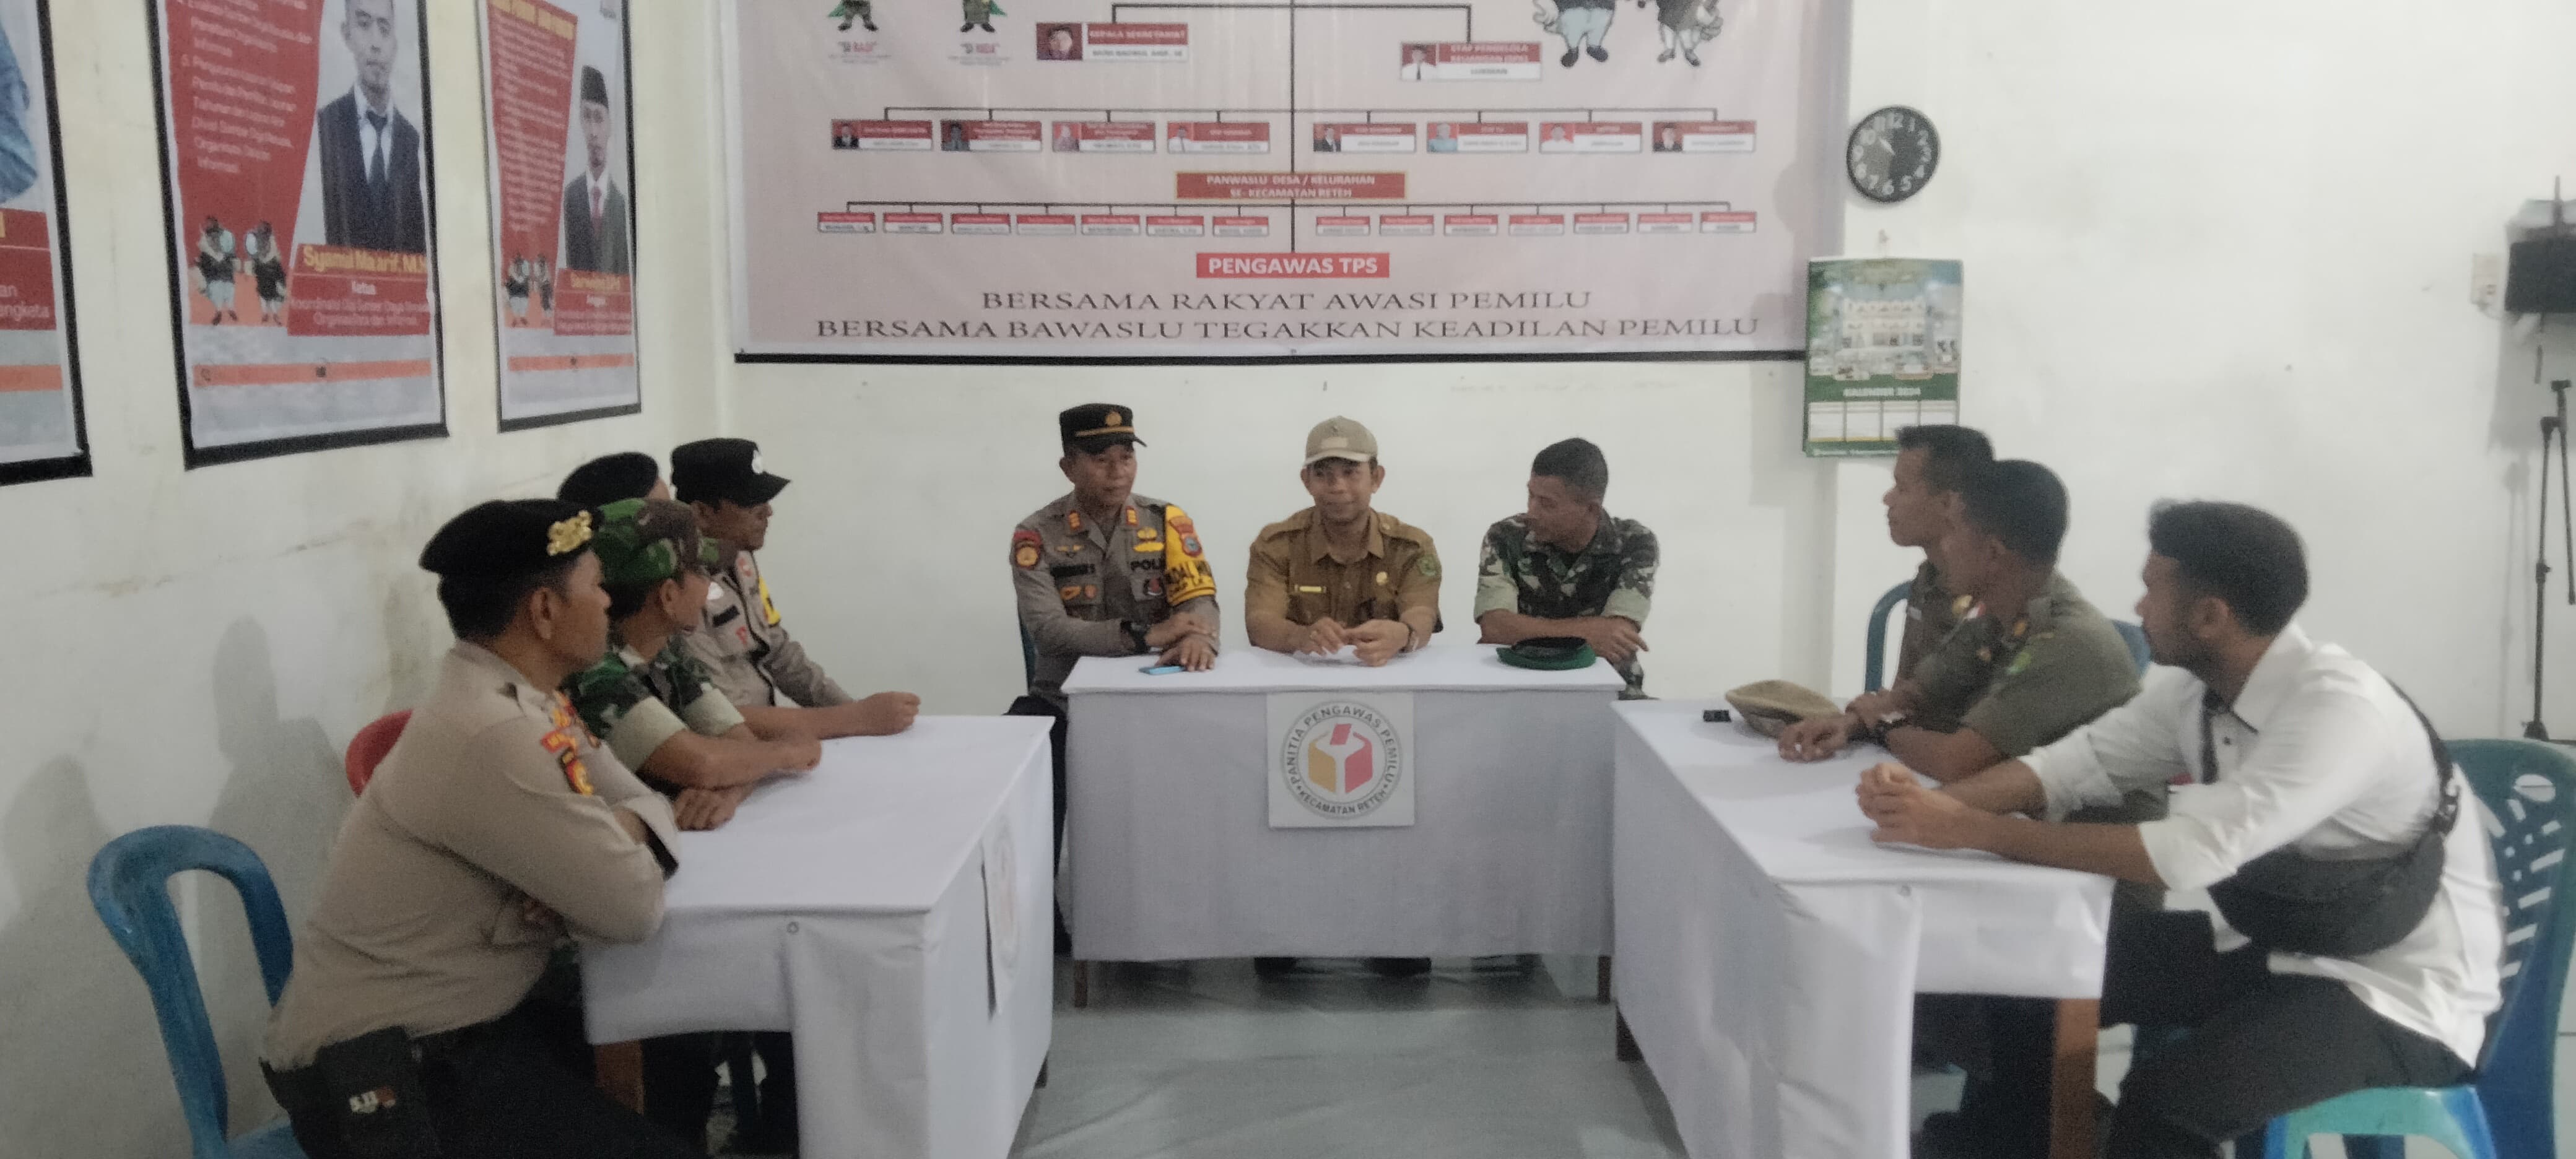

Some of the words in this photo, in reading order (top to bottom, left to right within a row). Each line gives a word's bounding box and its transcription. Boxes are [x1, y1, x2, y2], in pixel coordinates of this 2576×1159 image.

[1889, 113, 1904, 129] 12
[1908, 116, 1915, 132] 1
[1860, 129, 1876, 145] 10
[1917, 129, 1929, 145] 2
[1852, 145, 1864, 162] 9
[1921, 147, 1932, 162] 3
[1206, 175, 1269, 184] PANWASLU
[1273, 175, 1302, 184] DESA
[1311, 175, 1375, 184] KELURAHAN
[1855, 163, 1868, 180] 8
[1914, 165, 1925, 178] 4
[1868, 174, 1880, 190] 7
[1882, 180, 1895, 196] 6
[1900, 175, 1912, 191] 5
[1248, 188, 1316, 198] KECAMATAN
[1318, 188, 1352, 198] RETEH
[1208, 258, 1334, 274] PENGAWAS
[1339, 258, 1378, 274] TPS
[982, 292, 1159, 310] BERSAMA
[1171, 293, 1315, 311] RAKYAT
[1325, 293, 1438, 310] AWASI
[1450, 291, 1592, 310] PEMILU
[816, 319, 998, 339] BERSAMA
[1008, 321, 1184, 339] BAWASLU
[1193, 321, 1403, 339] TEGAKKAN
[1412, 320, 1607, 338] KEADILAN
[1618, 318, 1760, 336] PEMILU
[1286, 728, 1304, 784] PANITIA
[1303, 705, 1382, 728] PENGAWAS
[1380, 729, 1398, 783] PEMILU
[1299, 790, 1355, 815] KECAMATAN
[1357, 789, 1388, 811] RETEH
